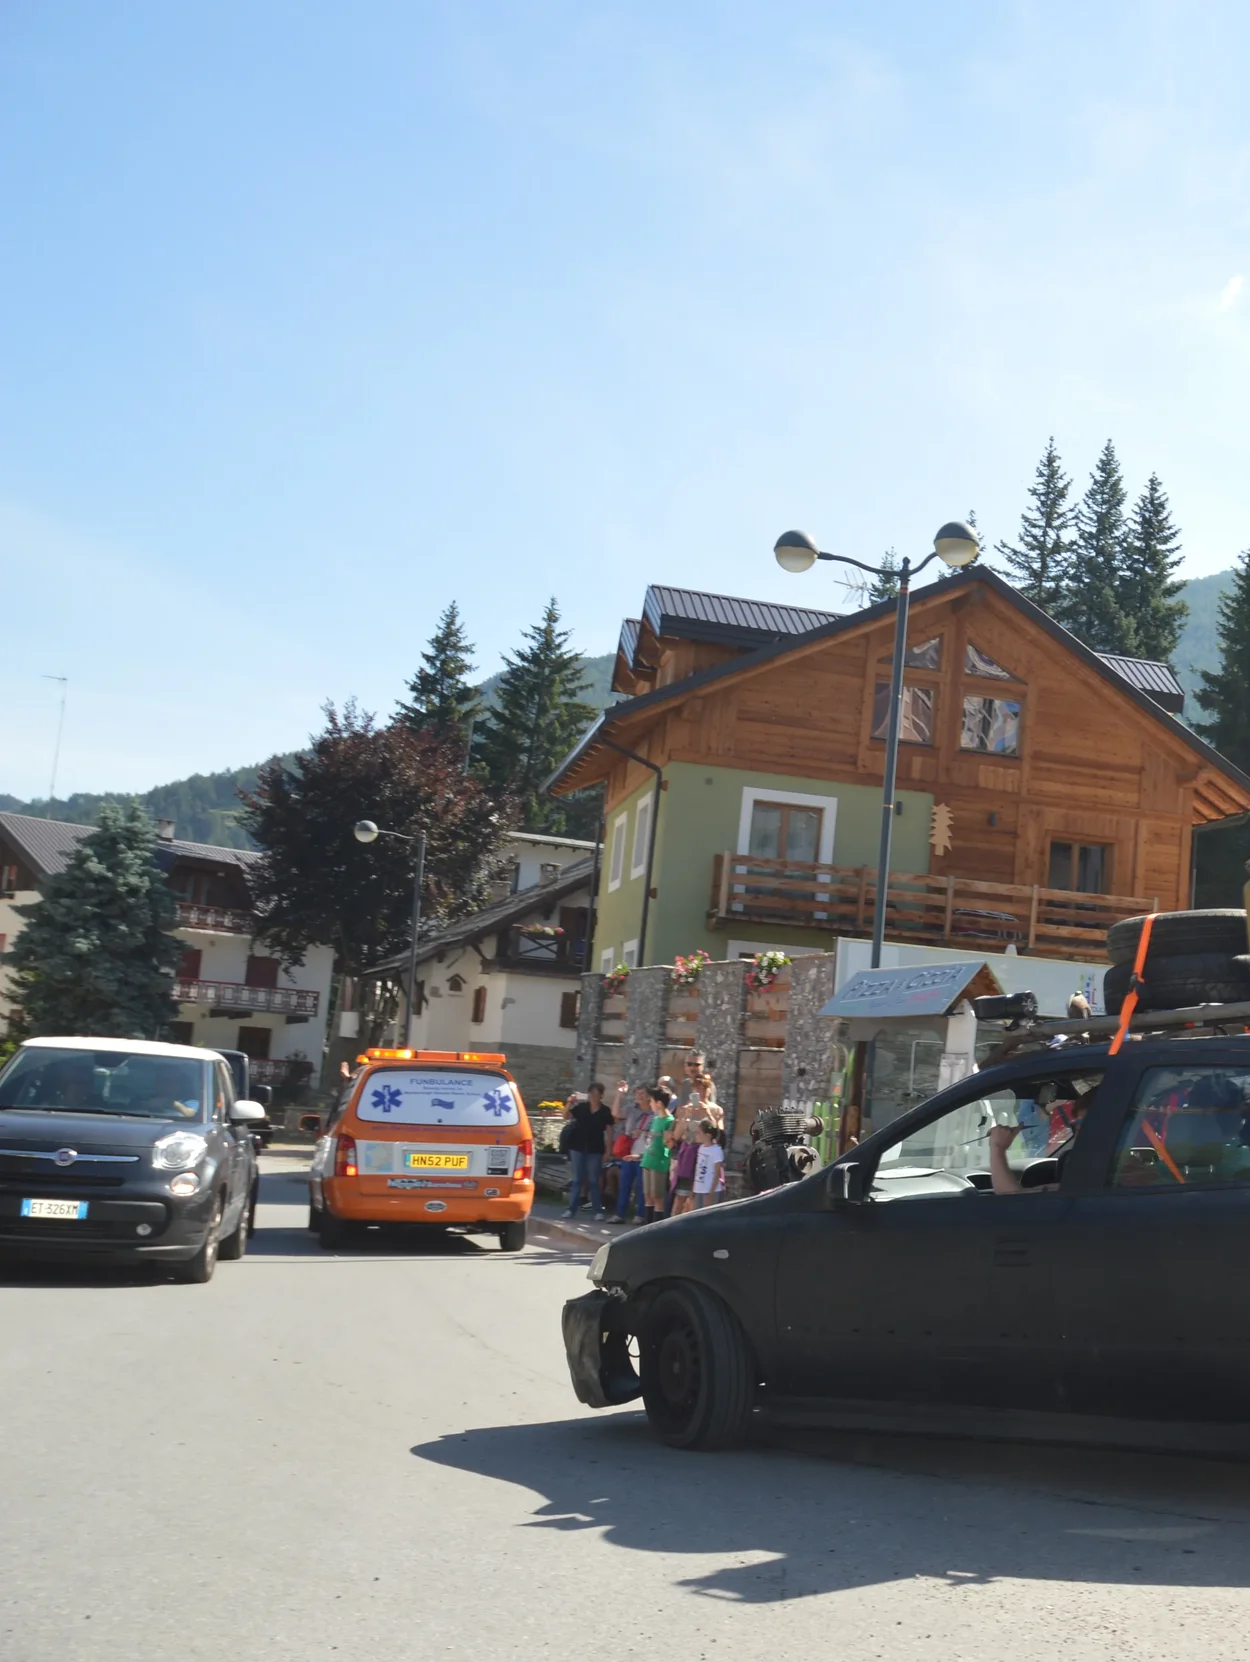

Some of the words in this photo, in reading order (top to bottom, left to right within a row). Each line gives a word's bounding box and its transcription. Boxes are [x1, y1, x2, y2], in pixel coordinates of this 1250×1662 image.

[410, 1078, 474, 1087] FUNBULANCE
[412, 1156, 441, 1167] HN52
[444, 1157, 467, 1167] PUF
